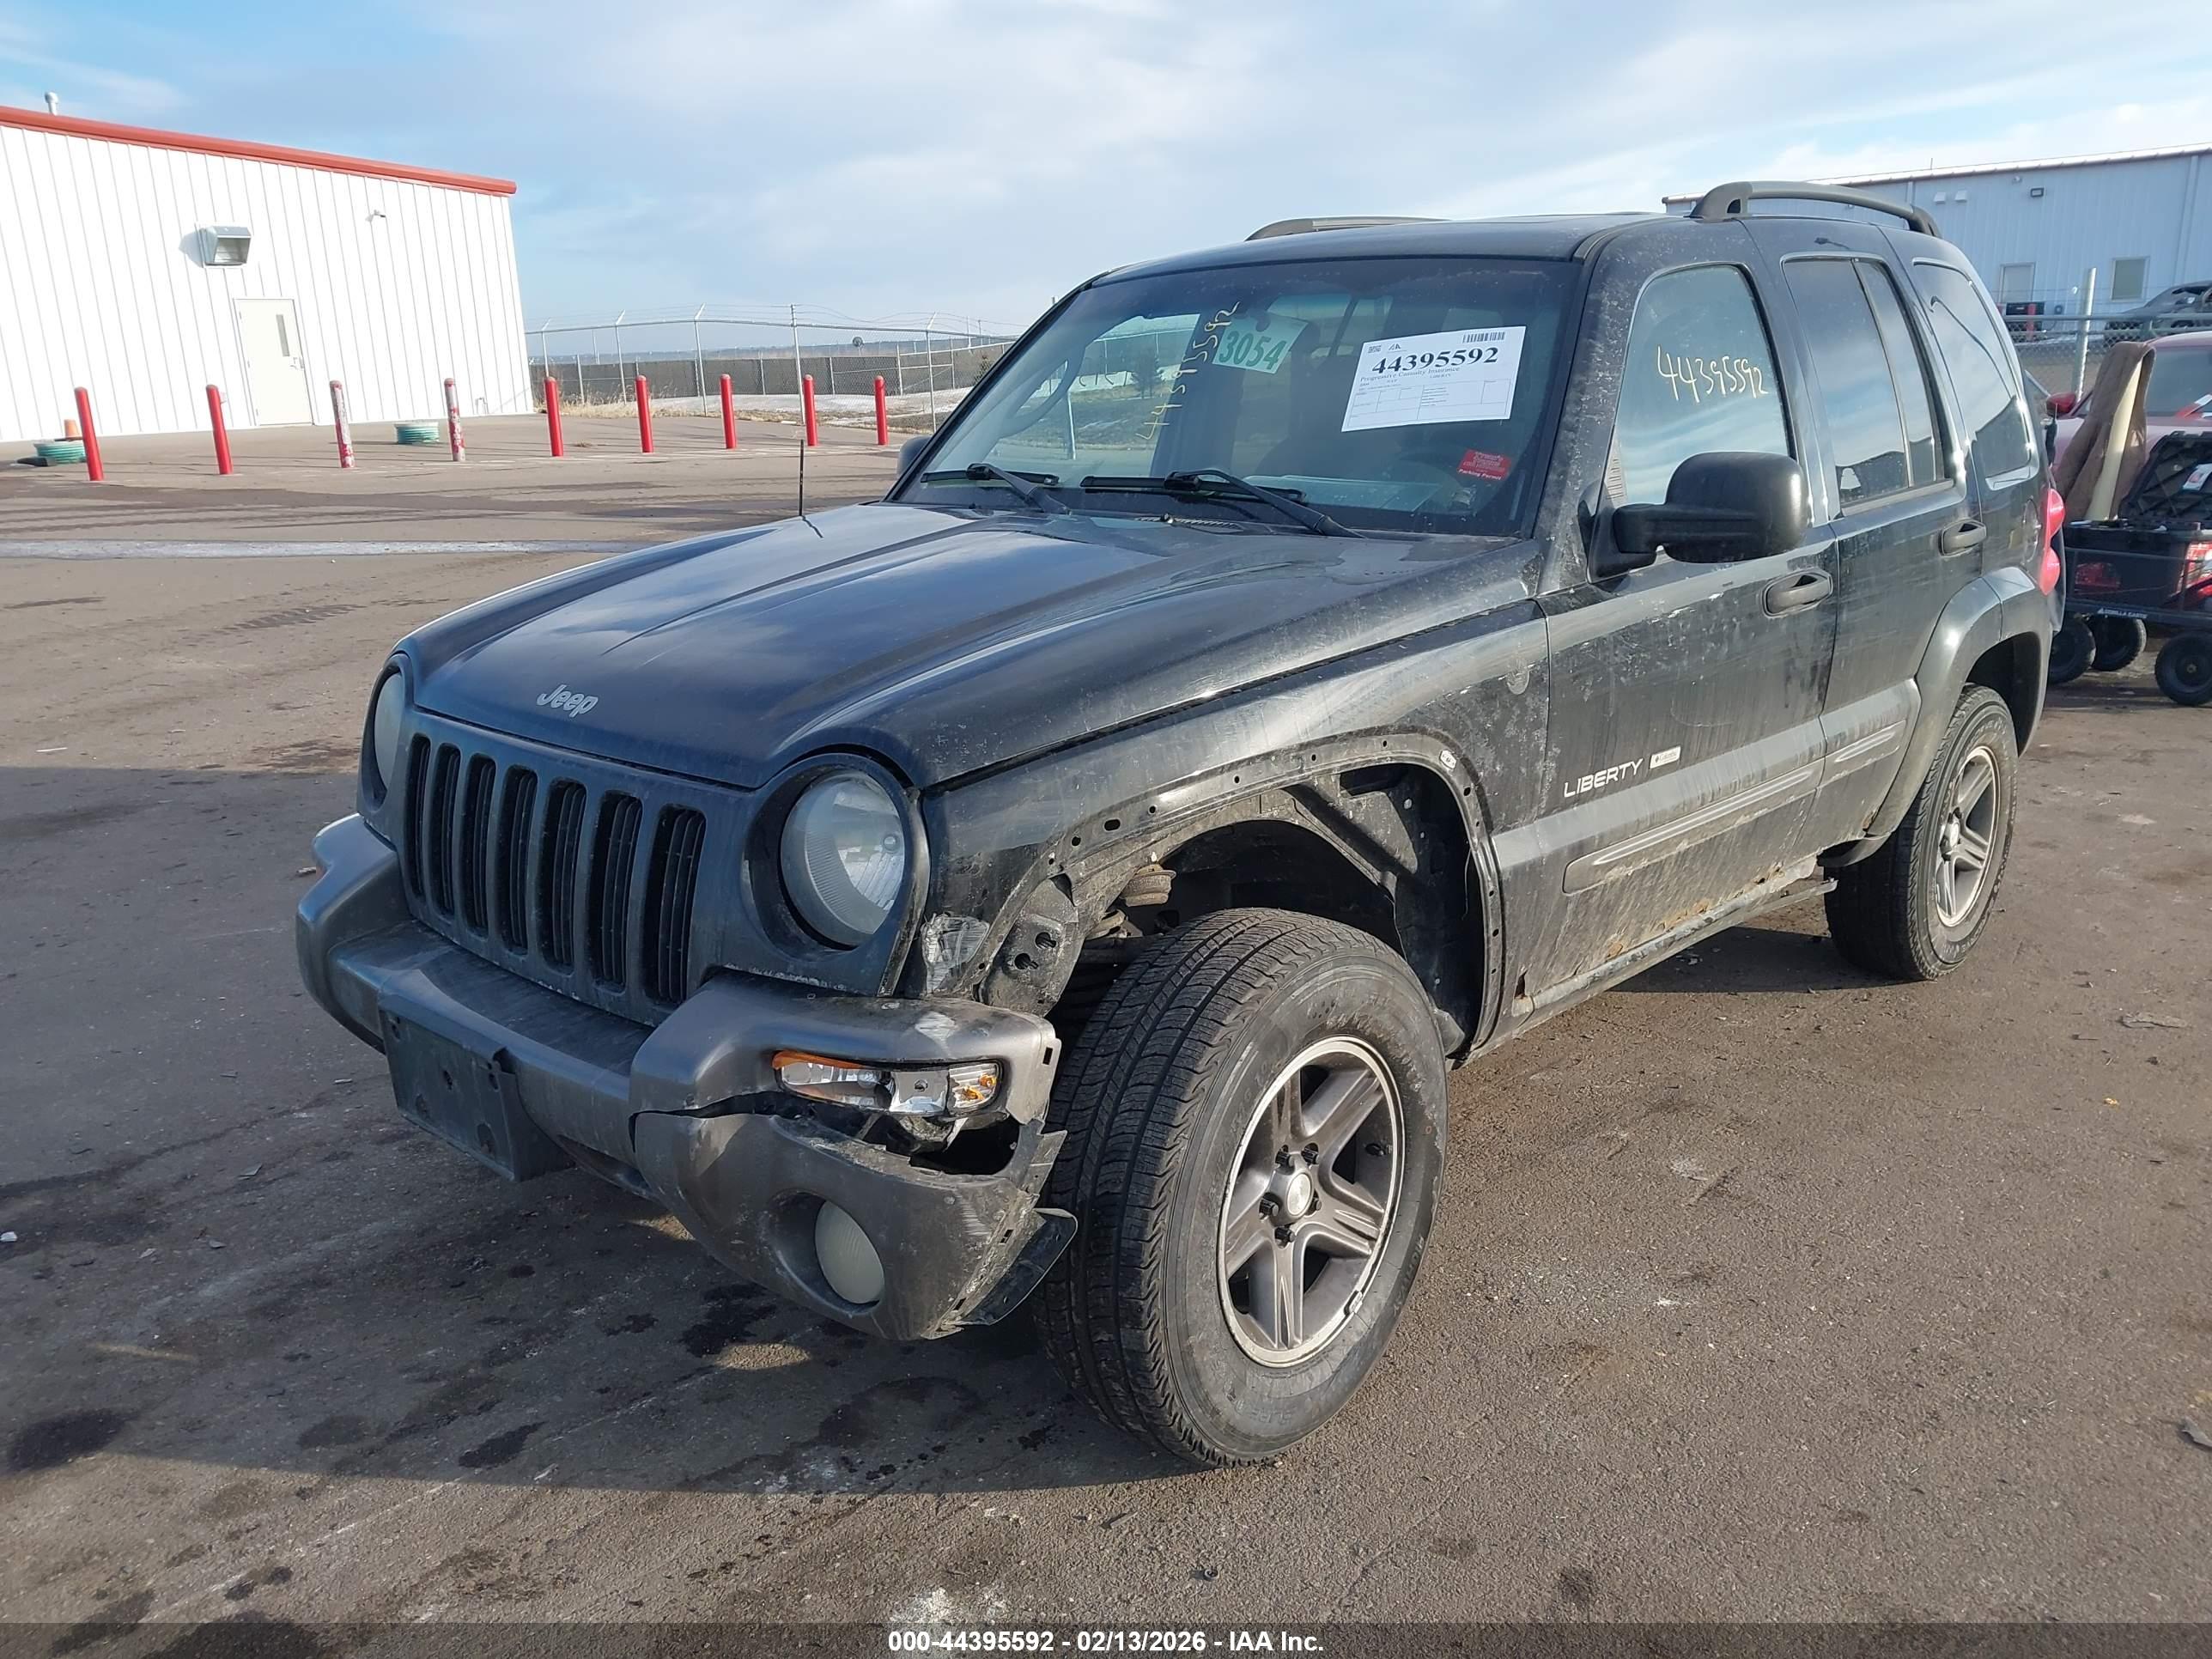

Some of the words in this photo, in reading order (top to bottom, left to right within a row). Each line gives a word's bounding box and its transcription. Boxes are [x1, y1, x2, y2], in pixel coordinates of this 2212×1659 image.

[1218, 330, 1286, 370] 3054
[1372, 346, 1498, 374] 44395592
[1657, 345, 1769, 403] 44395592
[537, 684, 599, 718] Jeep
[1564, 757, 1644, 798] LIBERTY
